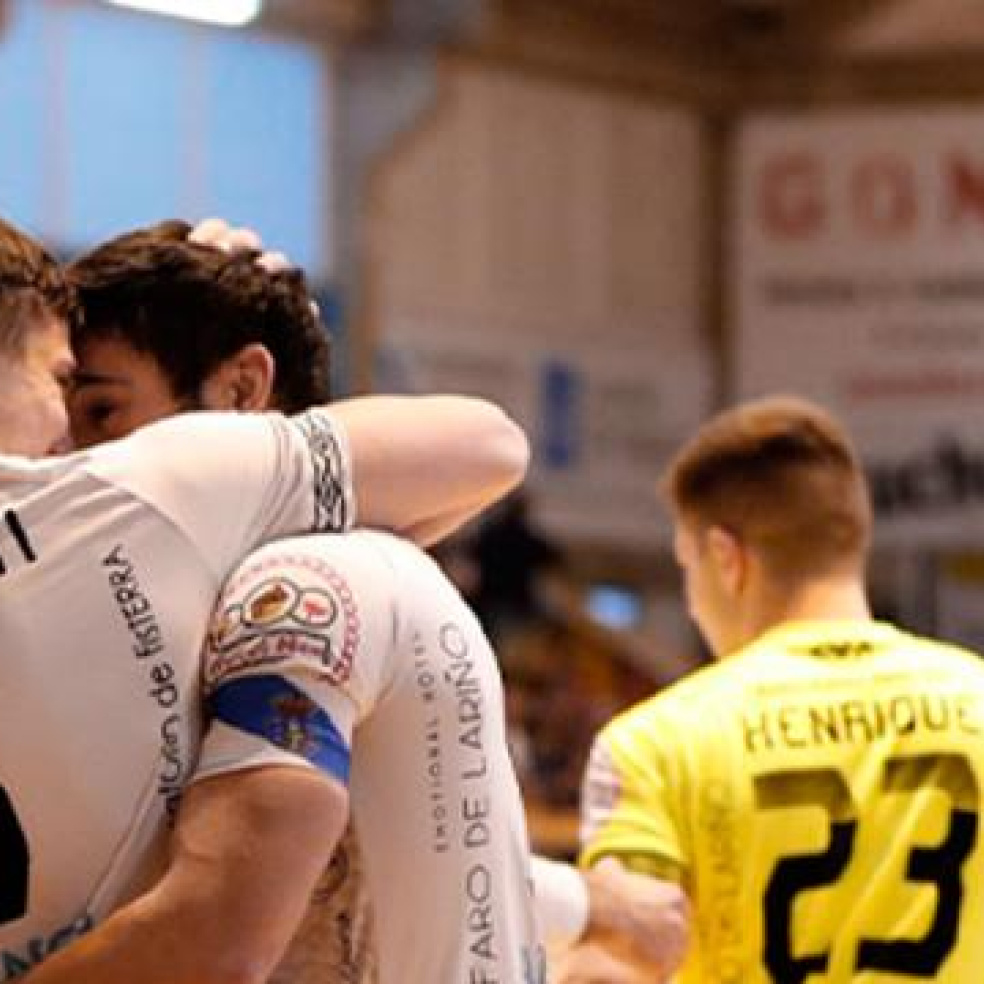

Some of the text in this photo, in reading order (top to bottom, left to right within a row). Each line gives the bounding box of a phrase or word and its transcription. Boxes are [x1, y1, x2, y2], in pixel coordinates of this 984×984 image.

[147, 662, 178, 708] de
[439, 621, 488, 780] LARIÑO
[743, 695, 983, 752] HENRIQUE
[462, 797, 491, 848] DE
